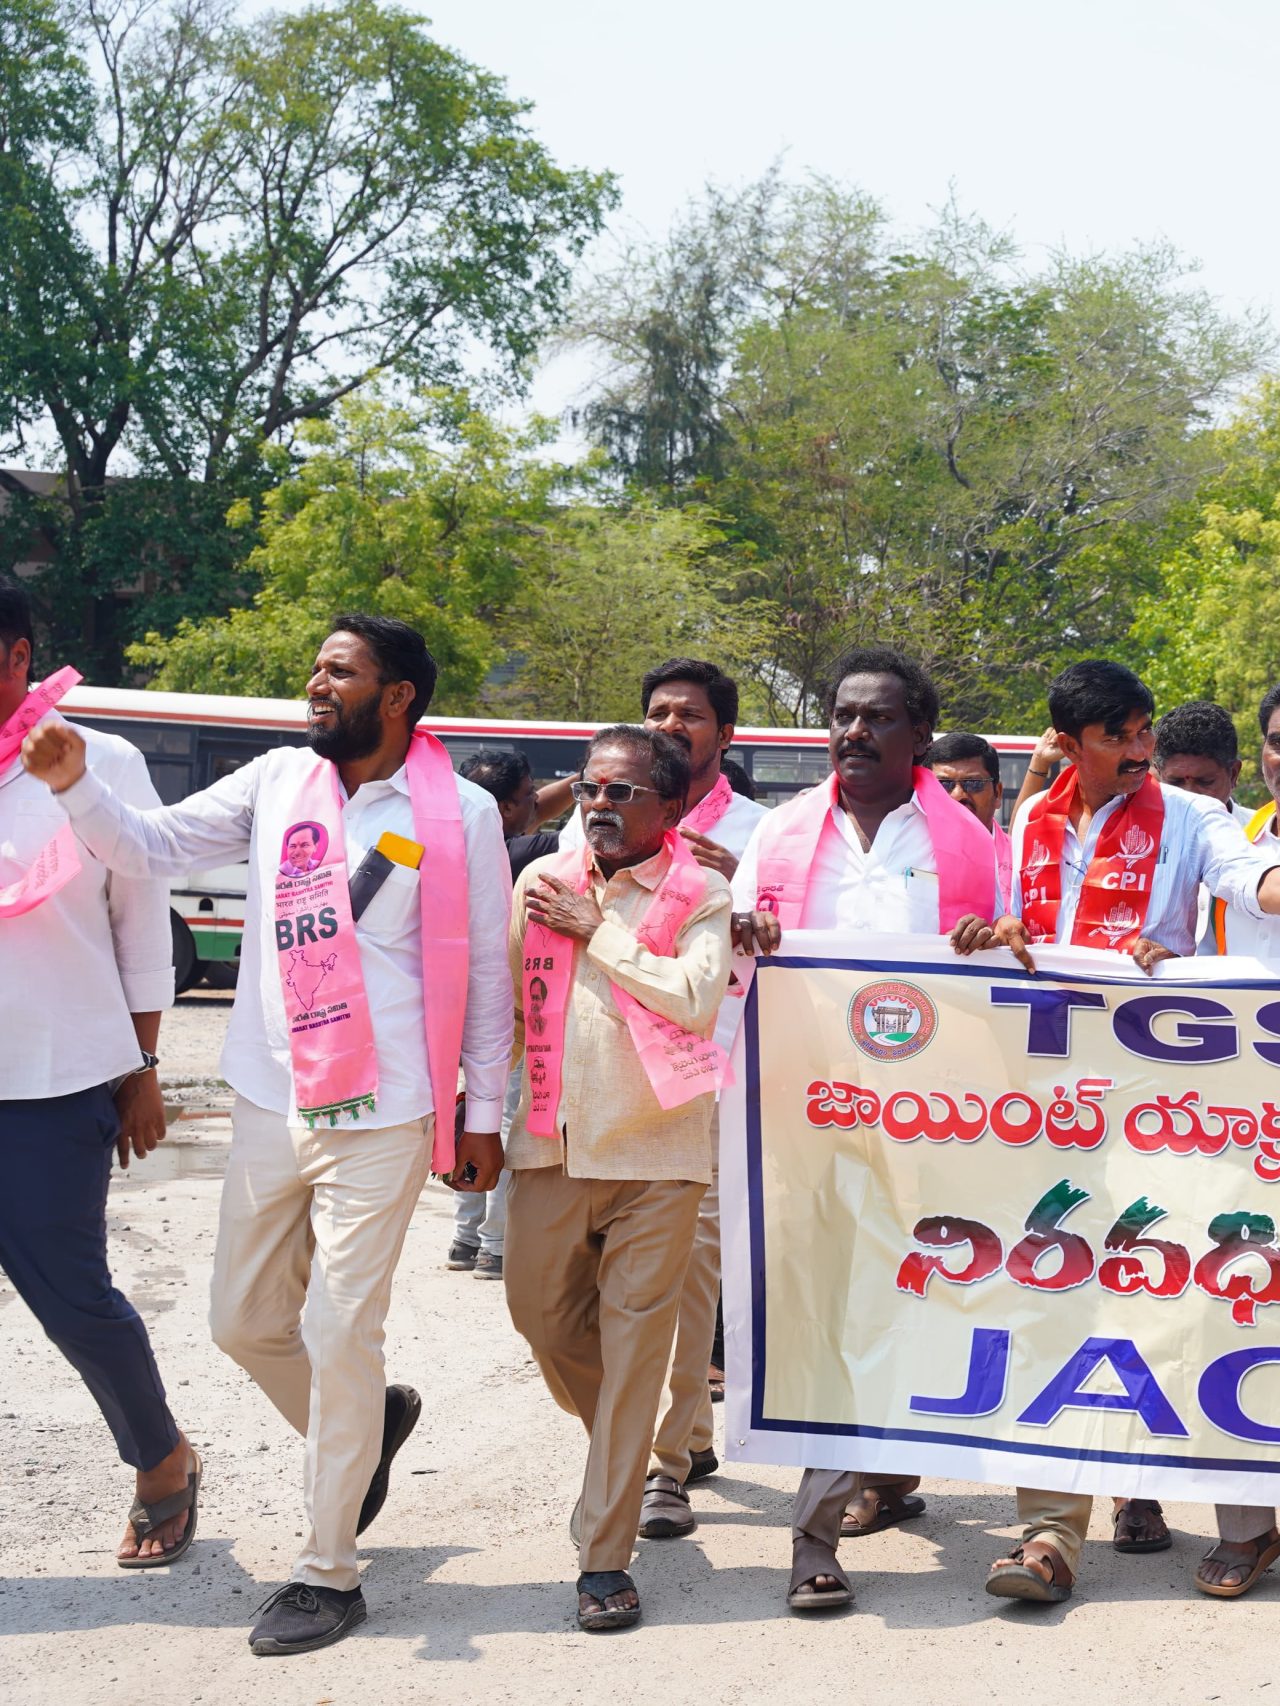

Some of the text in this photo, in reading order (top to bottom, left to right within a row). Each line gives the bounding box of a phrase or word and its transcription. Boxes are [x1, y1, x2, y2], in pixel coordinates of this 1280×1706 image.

[1023, 885, 1048, 909] CPI
[1101, 871, 1147, 892] CPI
[275, 906, 338, 952] BRS
[806, 1078, 1114, 1148] జాయింట్
